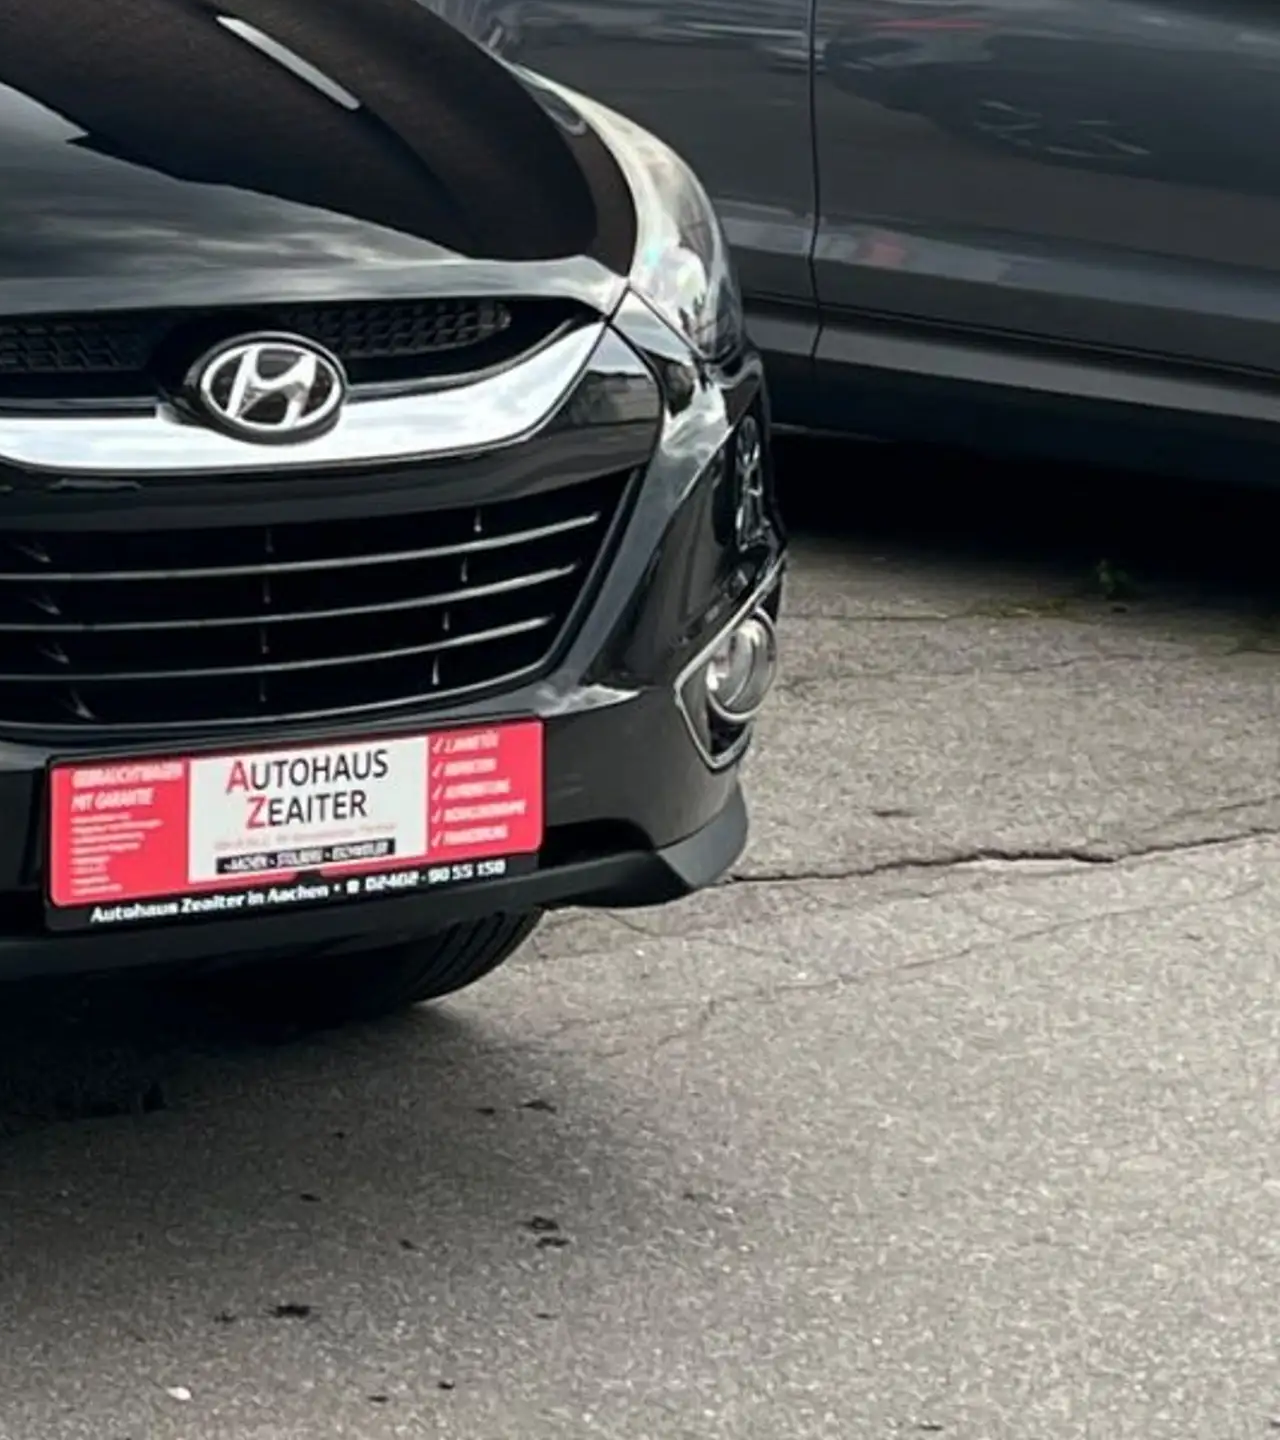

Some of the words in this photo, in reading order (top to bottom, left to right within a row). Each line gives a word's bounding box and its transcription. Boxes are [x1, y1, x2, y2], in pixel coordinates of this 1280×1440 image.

[225, 748, 390, 794] AUTOHAUS
[246, 789, 367, 830] ZEAITER
[90, 901, 178, 924] Autohaus
[180, 893, 244, 913] Zeaiter
[247, 890, 264, 905] in
[267, 884, 329, 903] Aachen
[477, 859, 506, 875] 150
